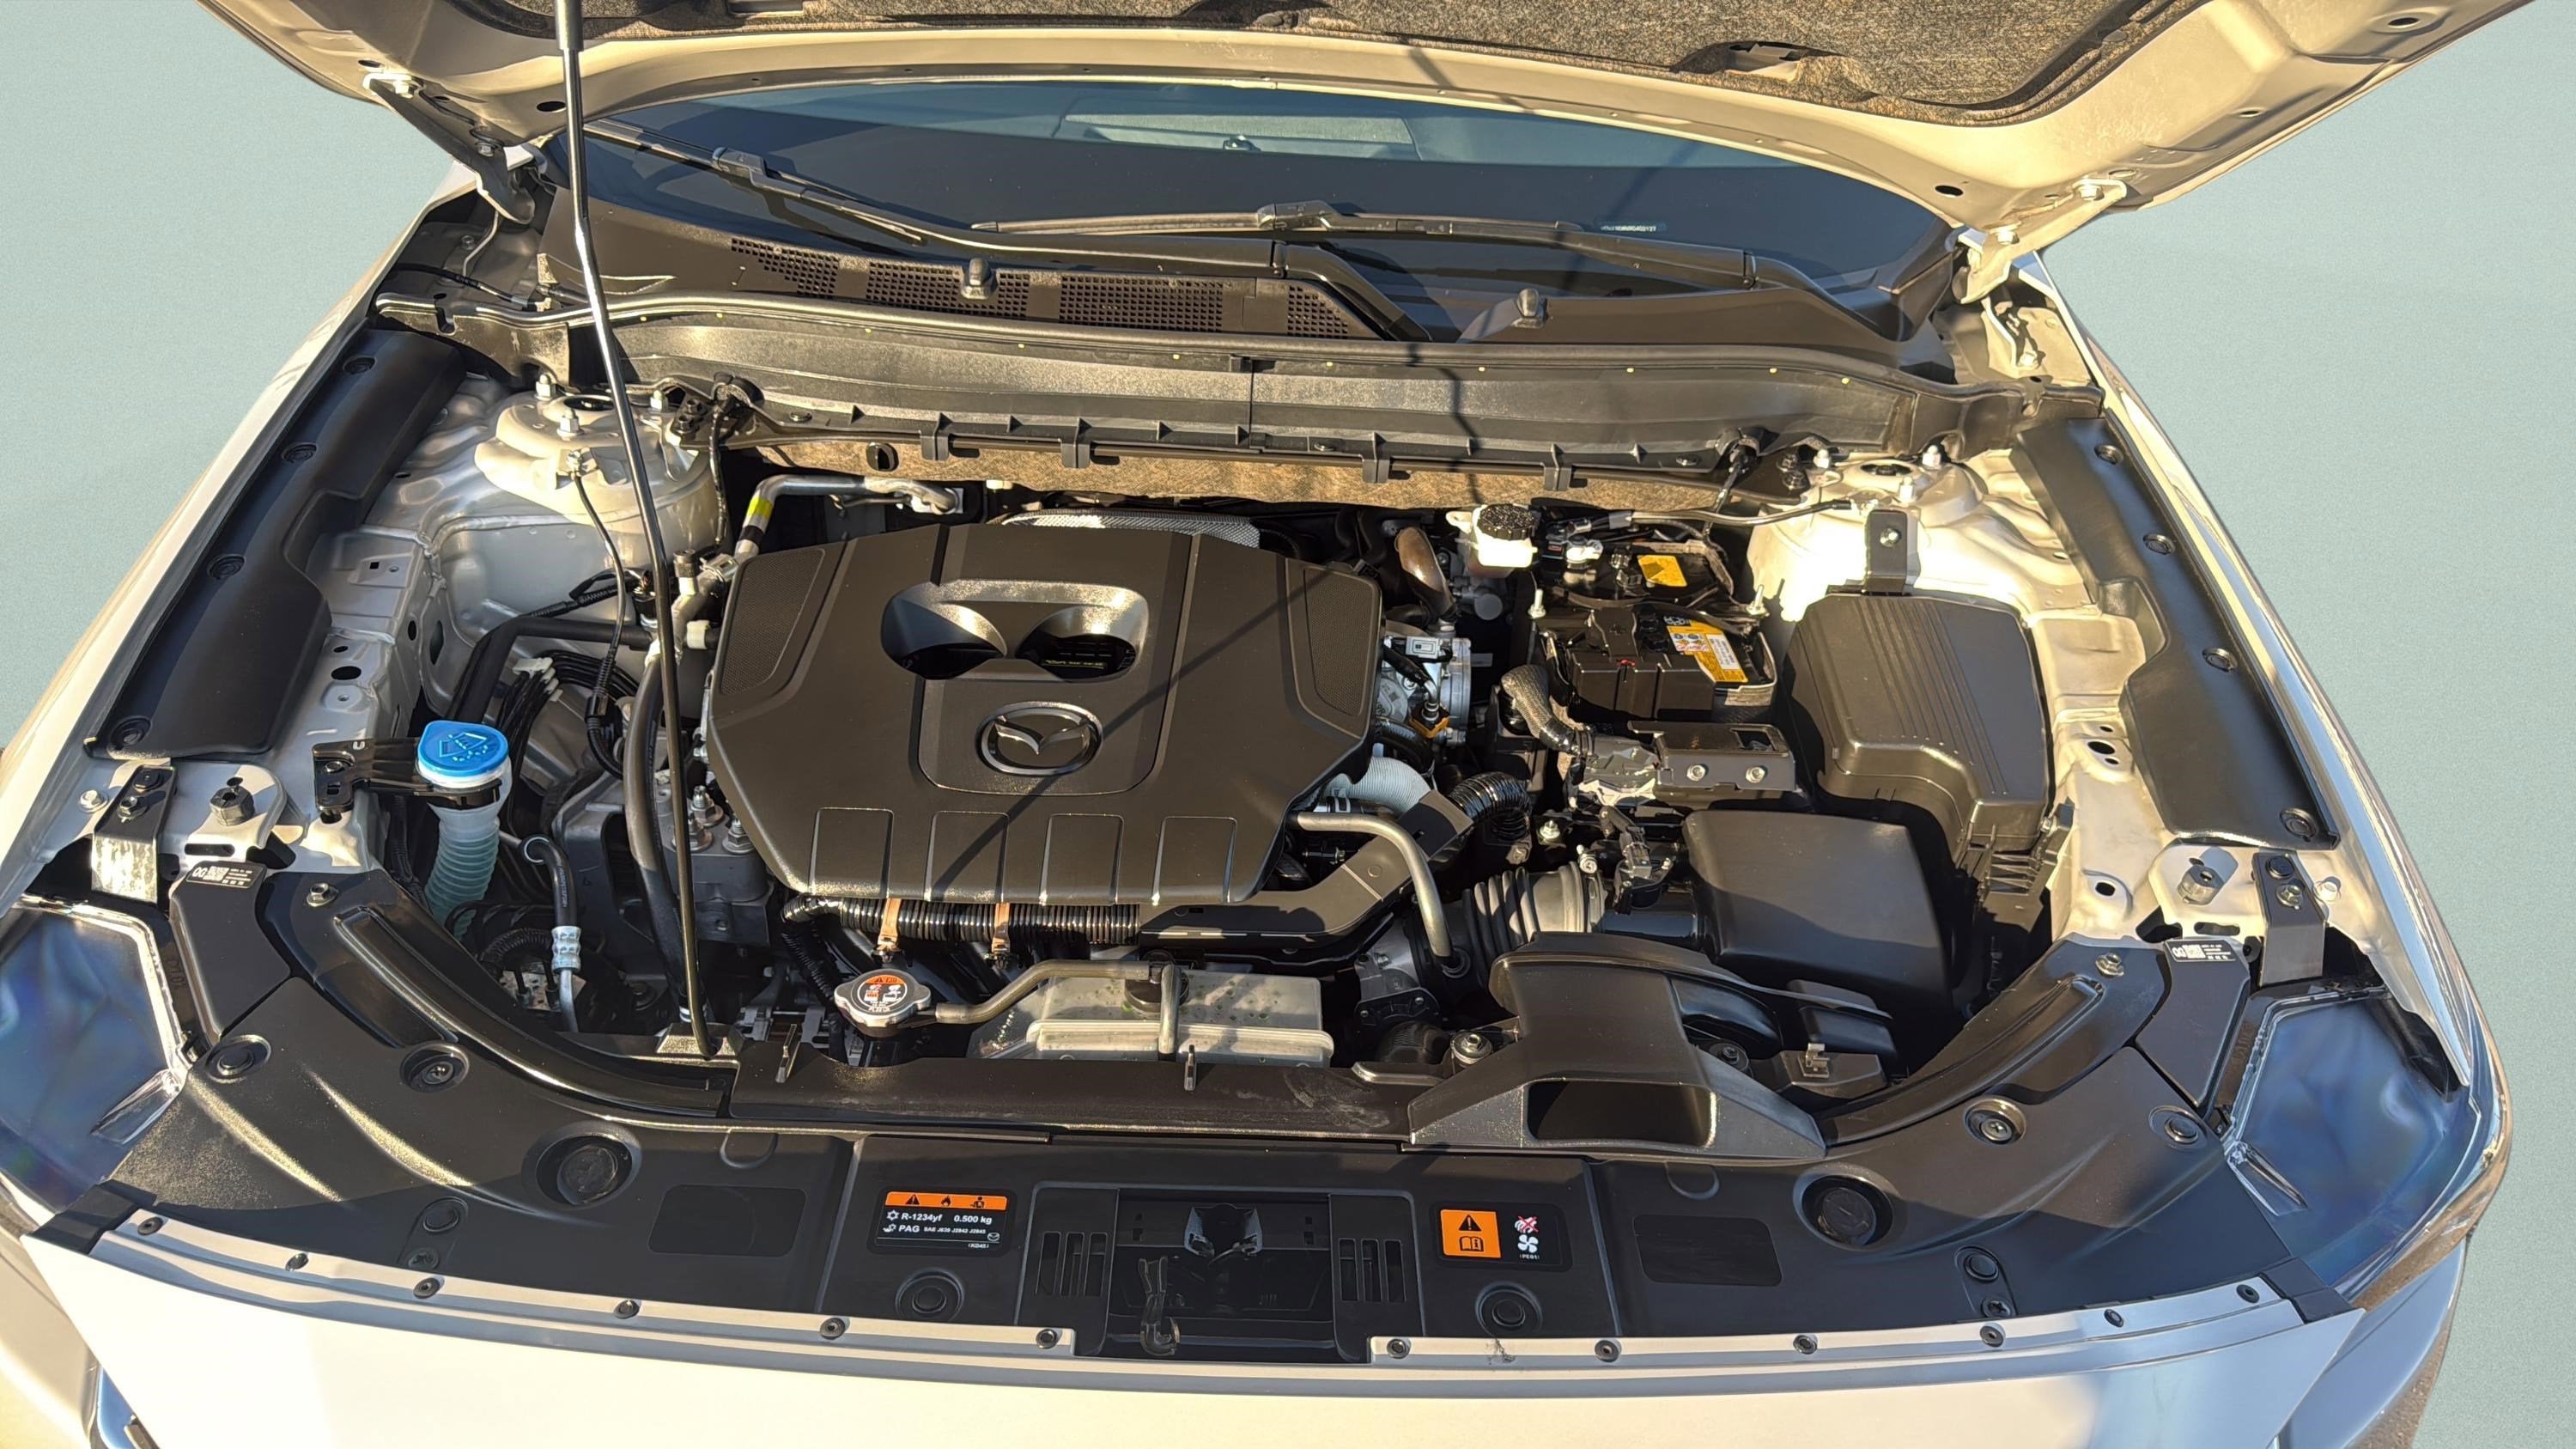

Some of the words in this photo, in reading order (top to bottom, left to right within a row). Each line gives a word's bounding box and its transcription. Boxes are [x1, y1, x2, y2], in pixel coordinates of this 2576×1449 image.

[901, 1212, 943, 1223] R-1234yf
[953, 1215, 979, 1223] 0.500
[980, 1216, 993, 1226] kg
[898, 1224, 920, 1233] PAG
